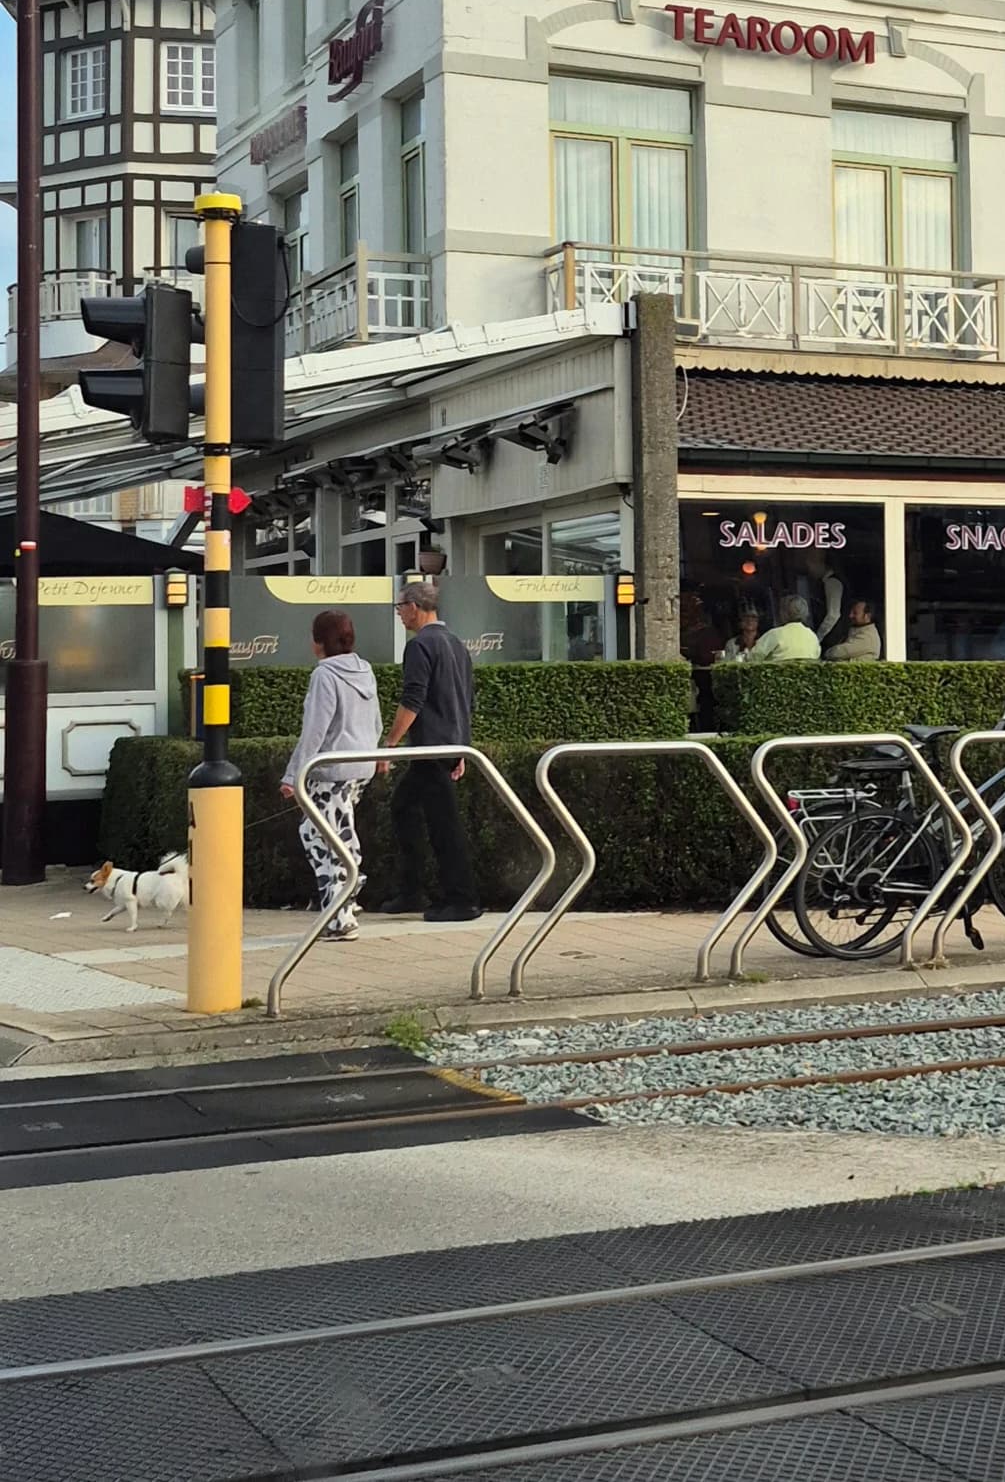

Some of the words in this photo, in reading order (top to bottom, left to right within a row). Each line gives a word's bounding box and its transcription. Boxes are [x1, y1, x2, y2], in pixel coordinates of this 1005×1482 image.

[664, 4, 875, 64] TEAROOM
[719, 520, 847, 549] SALADES
[305, 578, 357, 601] Ontbijt
[229, 634, 279, 661] aufort
